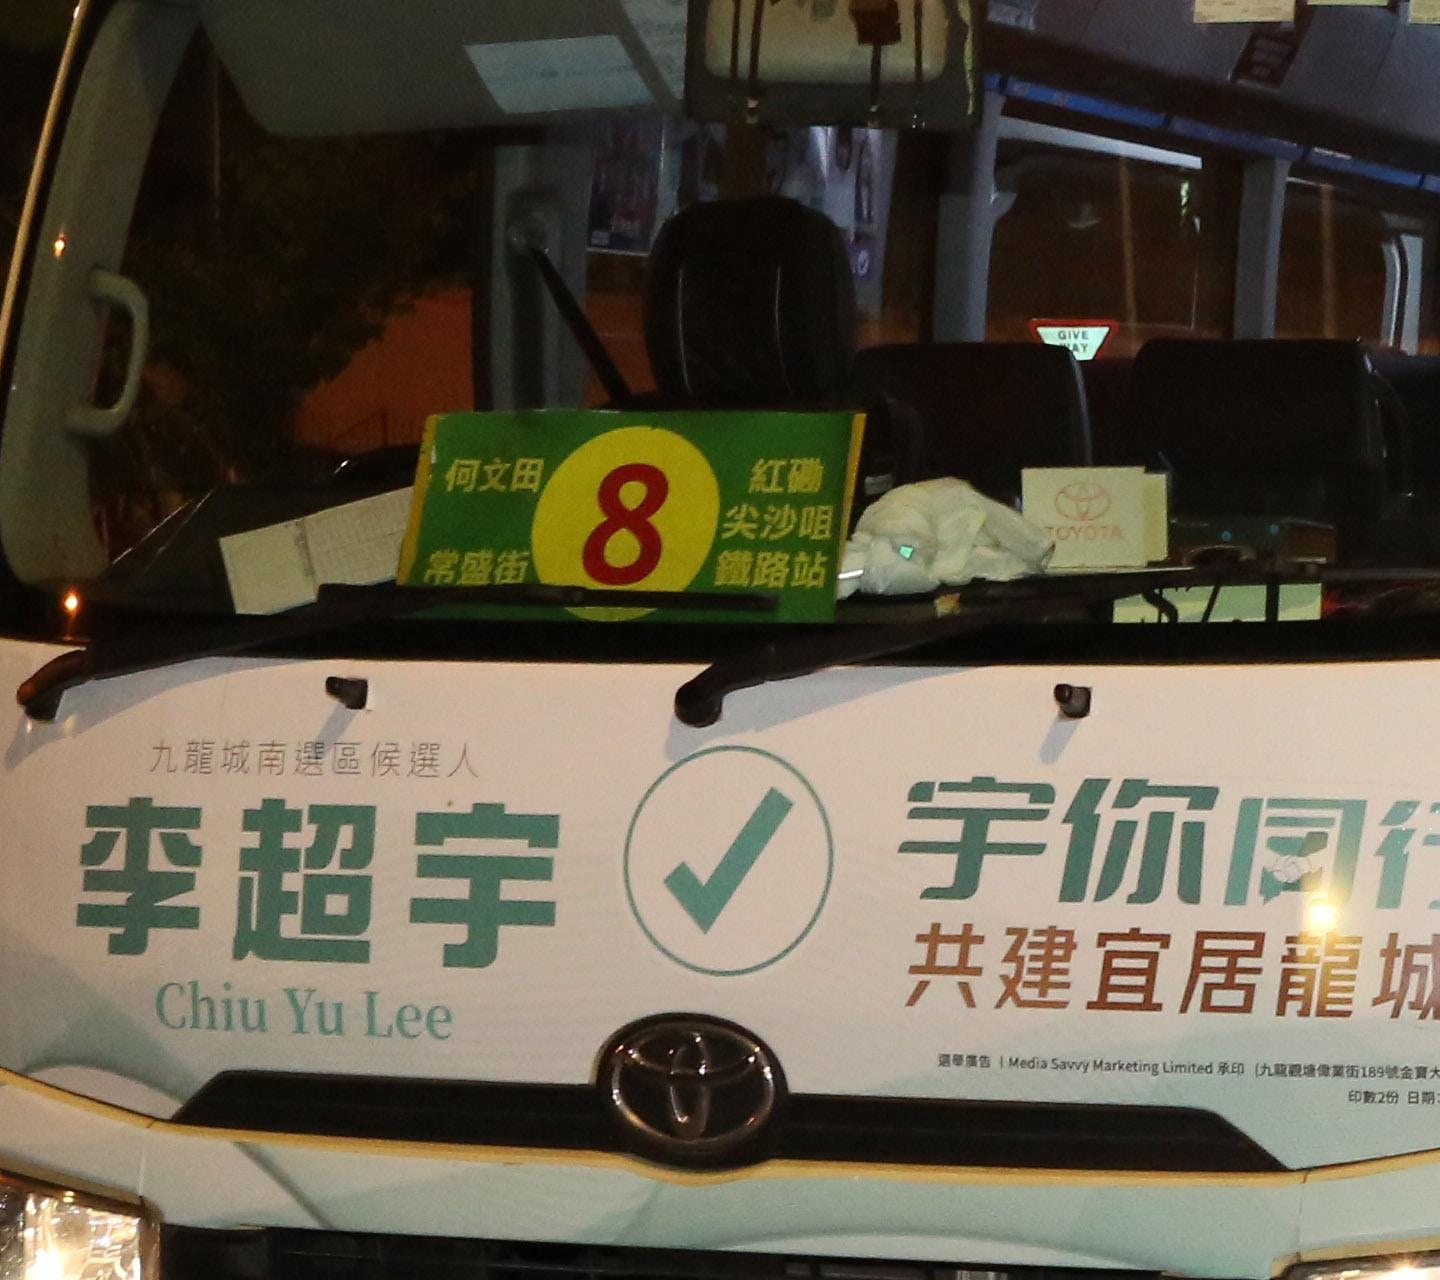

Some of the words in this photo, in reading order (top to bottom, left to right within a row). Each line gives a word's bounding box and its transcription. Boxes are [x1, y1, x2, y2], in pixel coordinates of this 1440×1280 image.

[1058, 330, 1089, 340] GIVE
[1063, 343, 1089, 352] AY
[445, 457, 545, 493] 何文田
[748, 457, 825, 494] 紅磡
[582, 463, 669, 586] 8
[721, 504, 834, 542] 尖沙咀
[1046, 525, 1123, 541] TOYOTA
[423, 548, 531, 586] 常盛街
[714, 550, 826, 589] 鐵路站
[149, 740, 479, 779] 九龍城南選區候選人
[76, 797, 560, 969] 李超宇
[155, 980, 268, 1033] Chiu
[283, 988, 346, 1036] Yu
[363, 992, 453, 1041] Lee
[1008, 1056, 1048, 1070] Media
[1051, 1057, 1089, 1074] Savvy
[1093, 1059, 1159, 1077] Marketing
[1163, 1061, 1214, 1075] Limited
[1217, 1061, 1245, 1076] 承印
